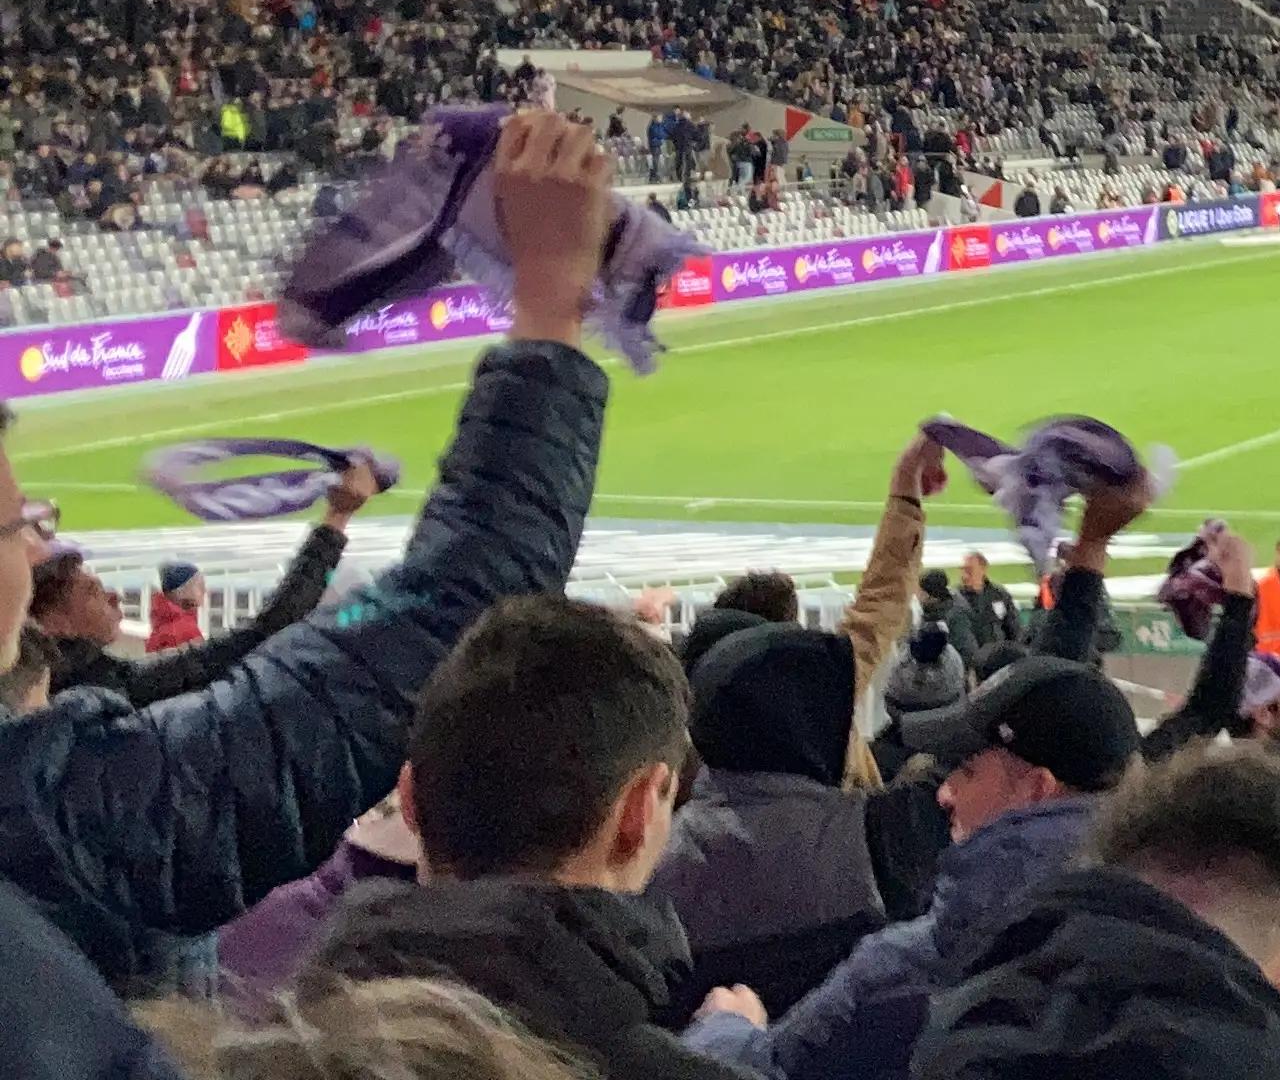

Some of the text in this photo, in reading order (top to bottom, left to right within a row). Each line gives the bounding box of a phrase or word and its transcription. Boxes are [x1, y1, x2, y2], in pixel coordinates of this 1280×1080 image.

[38, 332, 146, 372] Sud de France
